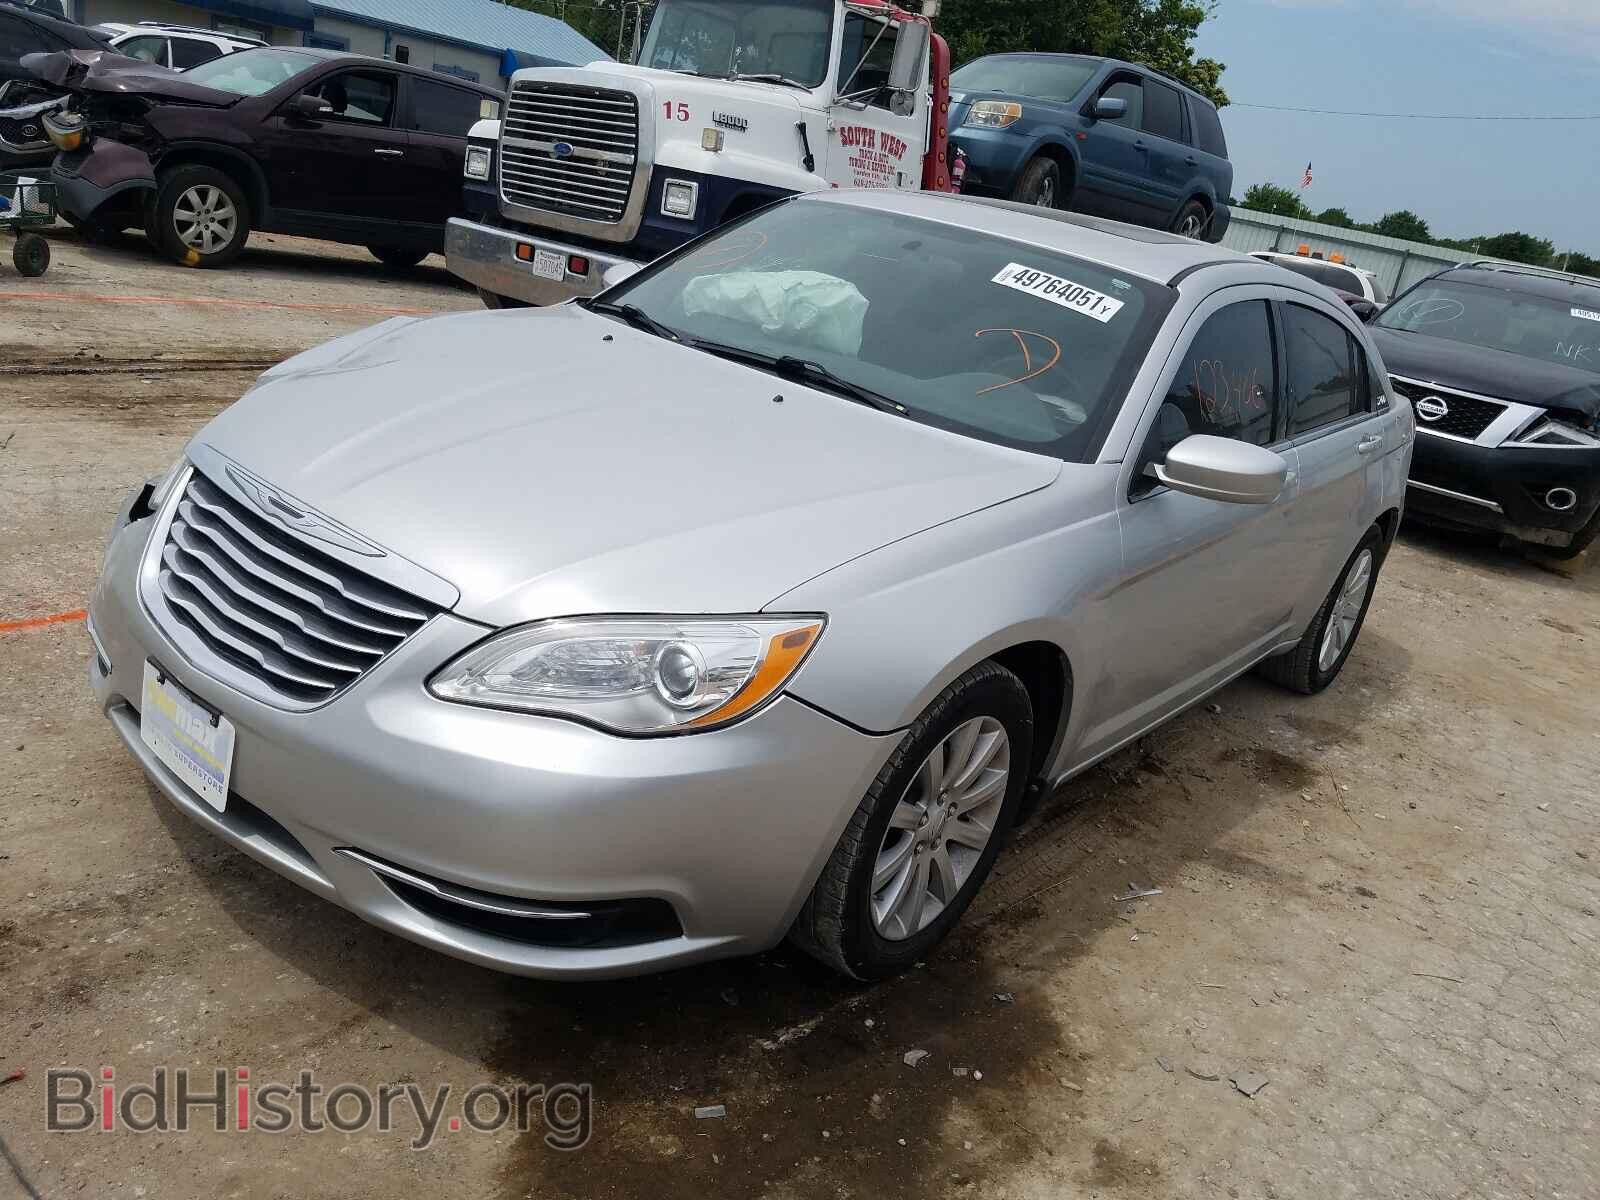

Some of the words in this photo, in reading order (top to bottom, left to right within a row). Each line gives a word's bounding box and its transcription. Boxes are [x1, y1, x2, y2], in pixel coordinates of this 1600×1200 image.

[662, 101, 690, 122] 15
[839, 126, 875, 149] SOUTH
[880, 131, 908, 160] WEST
[1418, 402, 1446, 415] NISSAN
